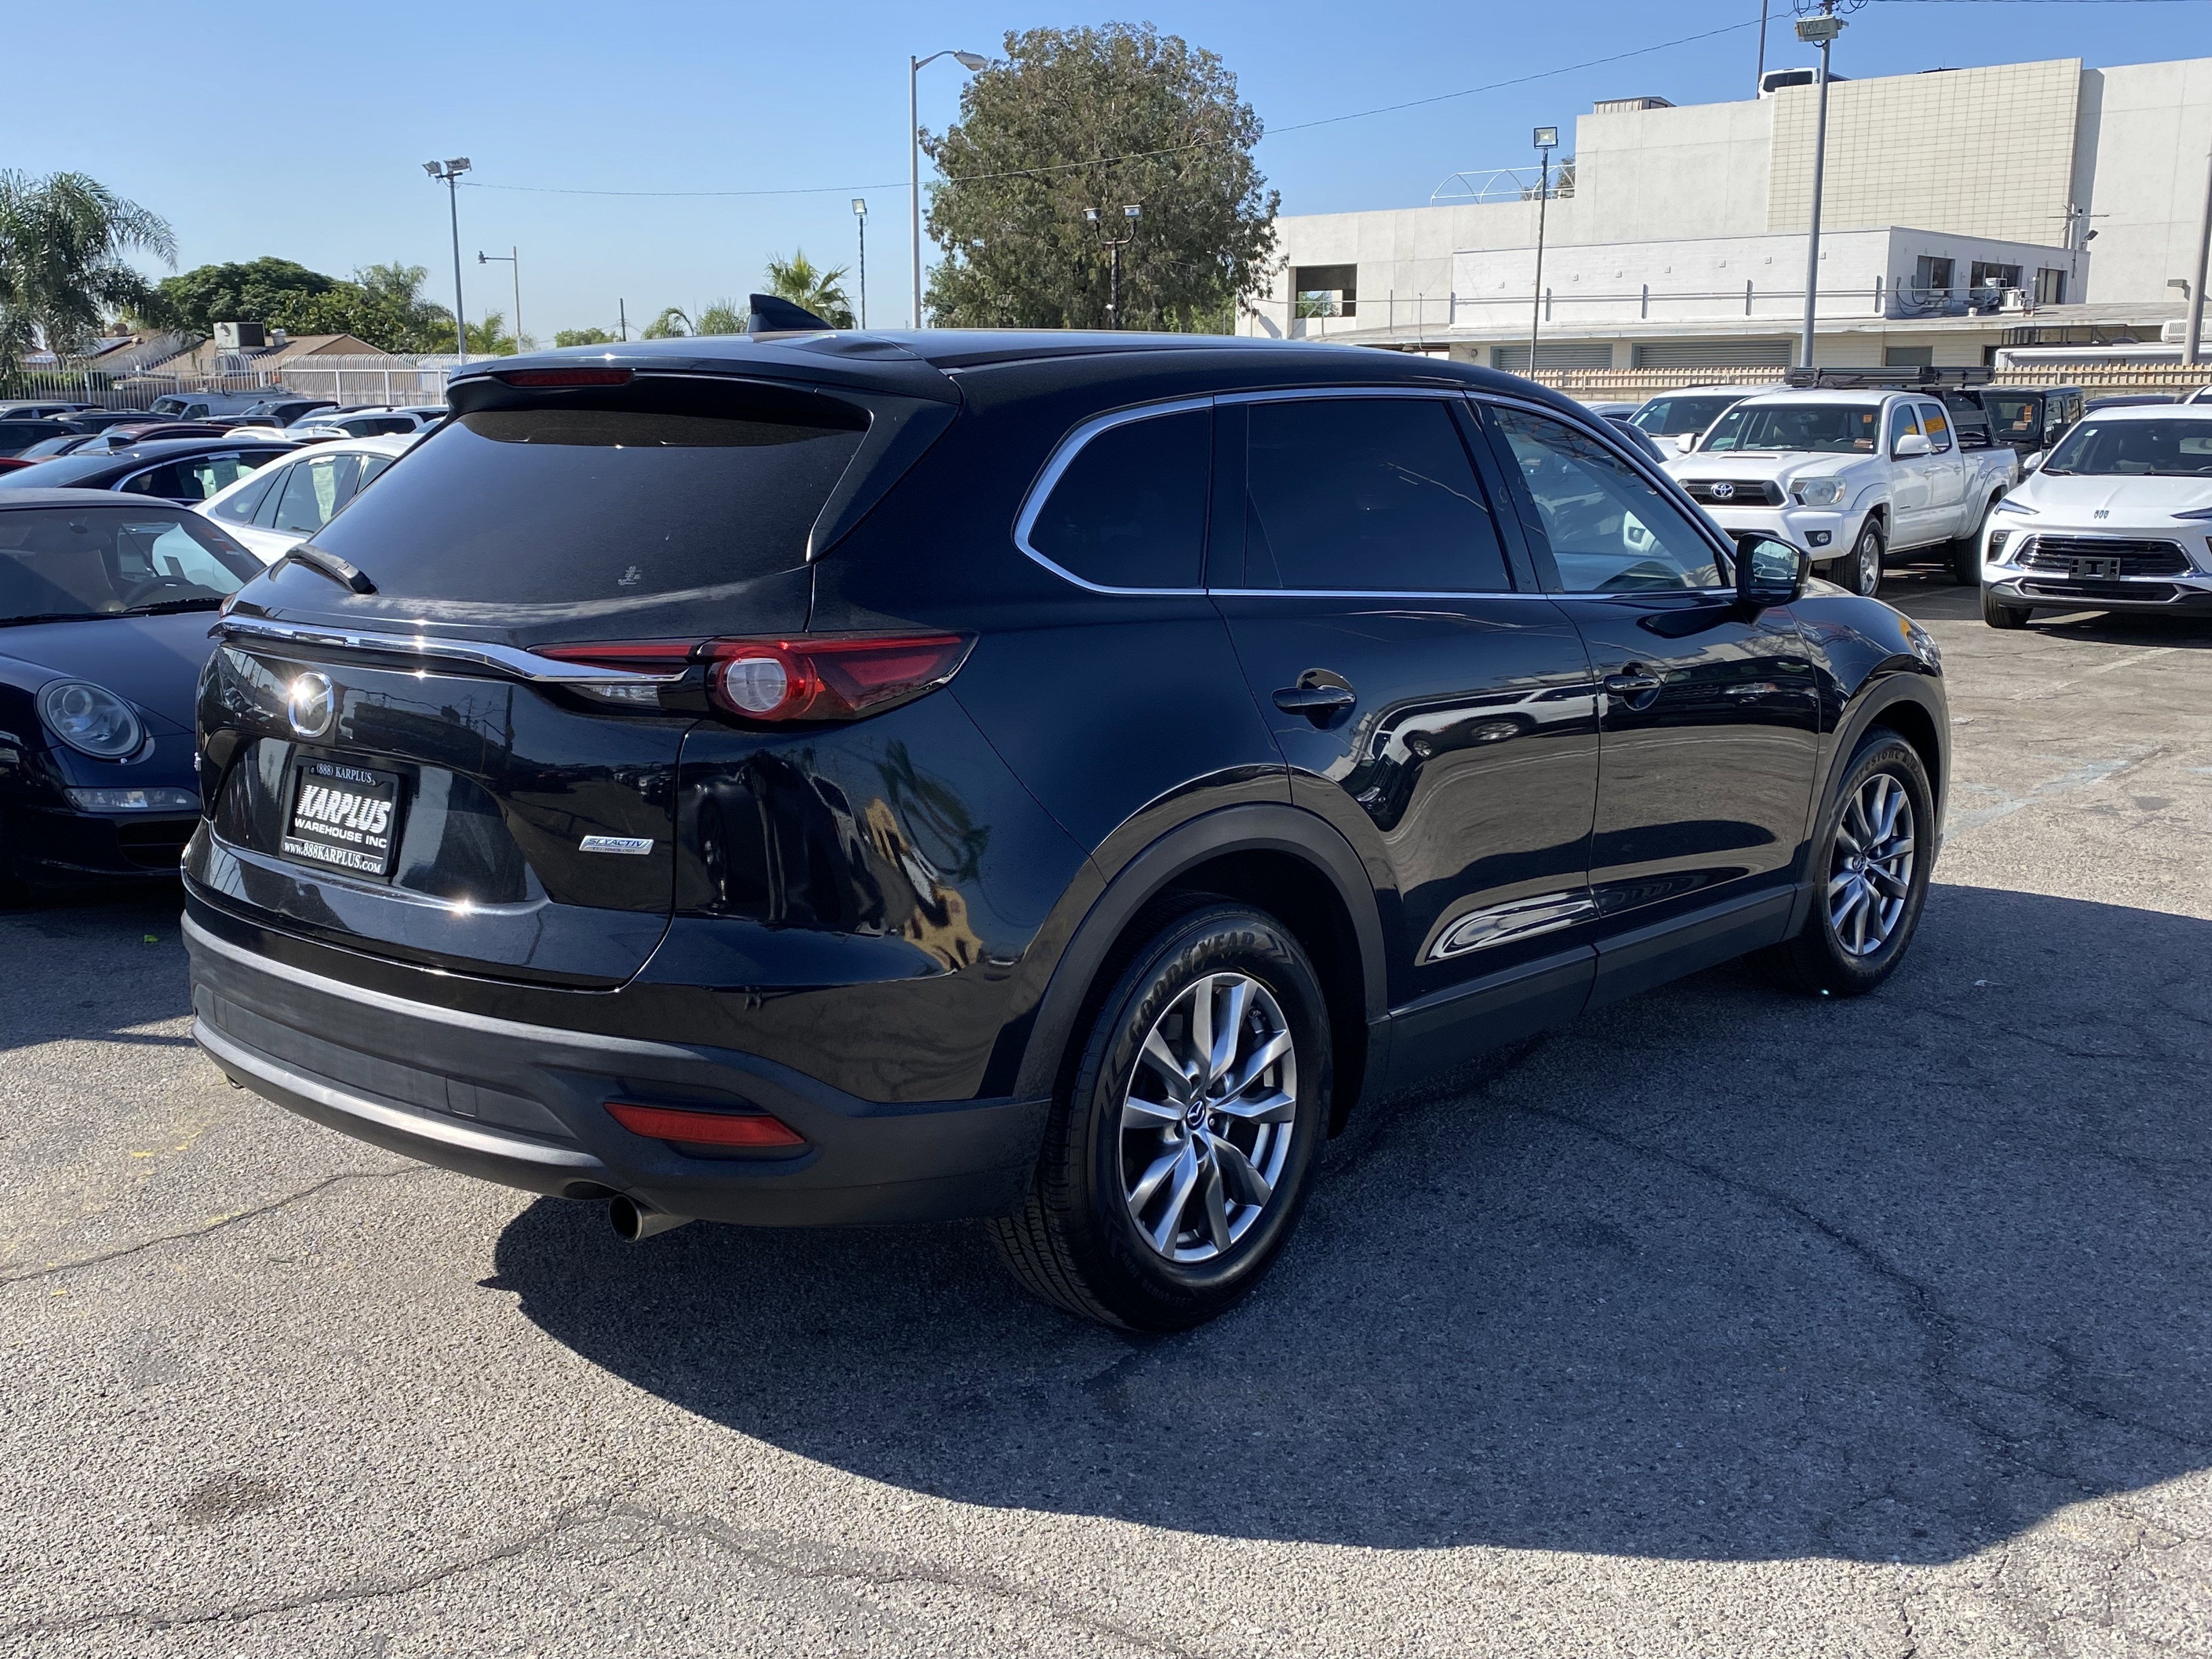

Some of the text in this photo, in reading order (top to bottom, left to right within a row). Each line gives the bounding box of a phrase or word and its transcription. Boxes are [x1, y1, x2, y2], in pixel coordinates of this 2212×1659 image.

[316, 763, 373, 783] (888) KARPLUS
[296, 785, 392, 833] KARPLUS
[295, 818, 387, 848] WAREHOUSE INC
[1129, 932, 1255, 1043] GOODYEAR
